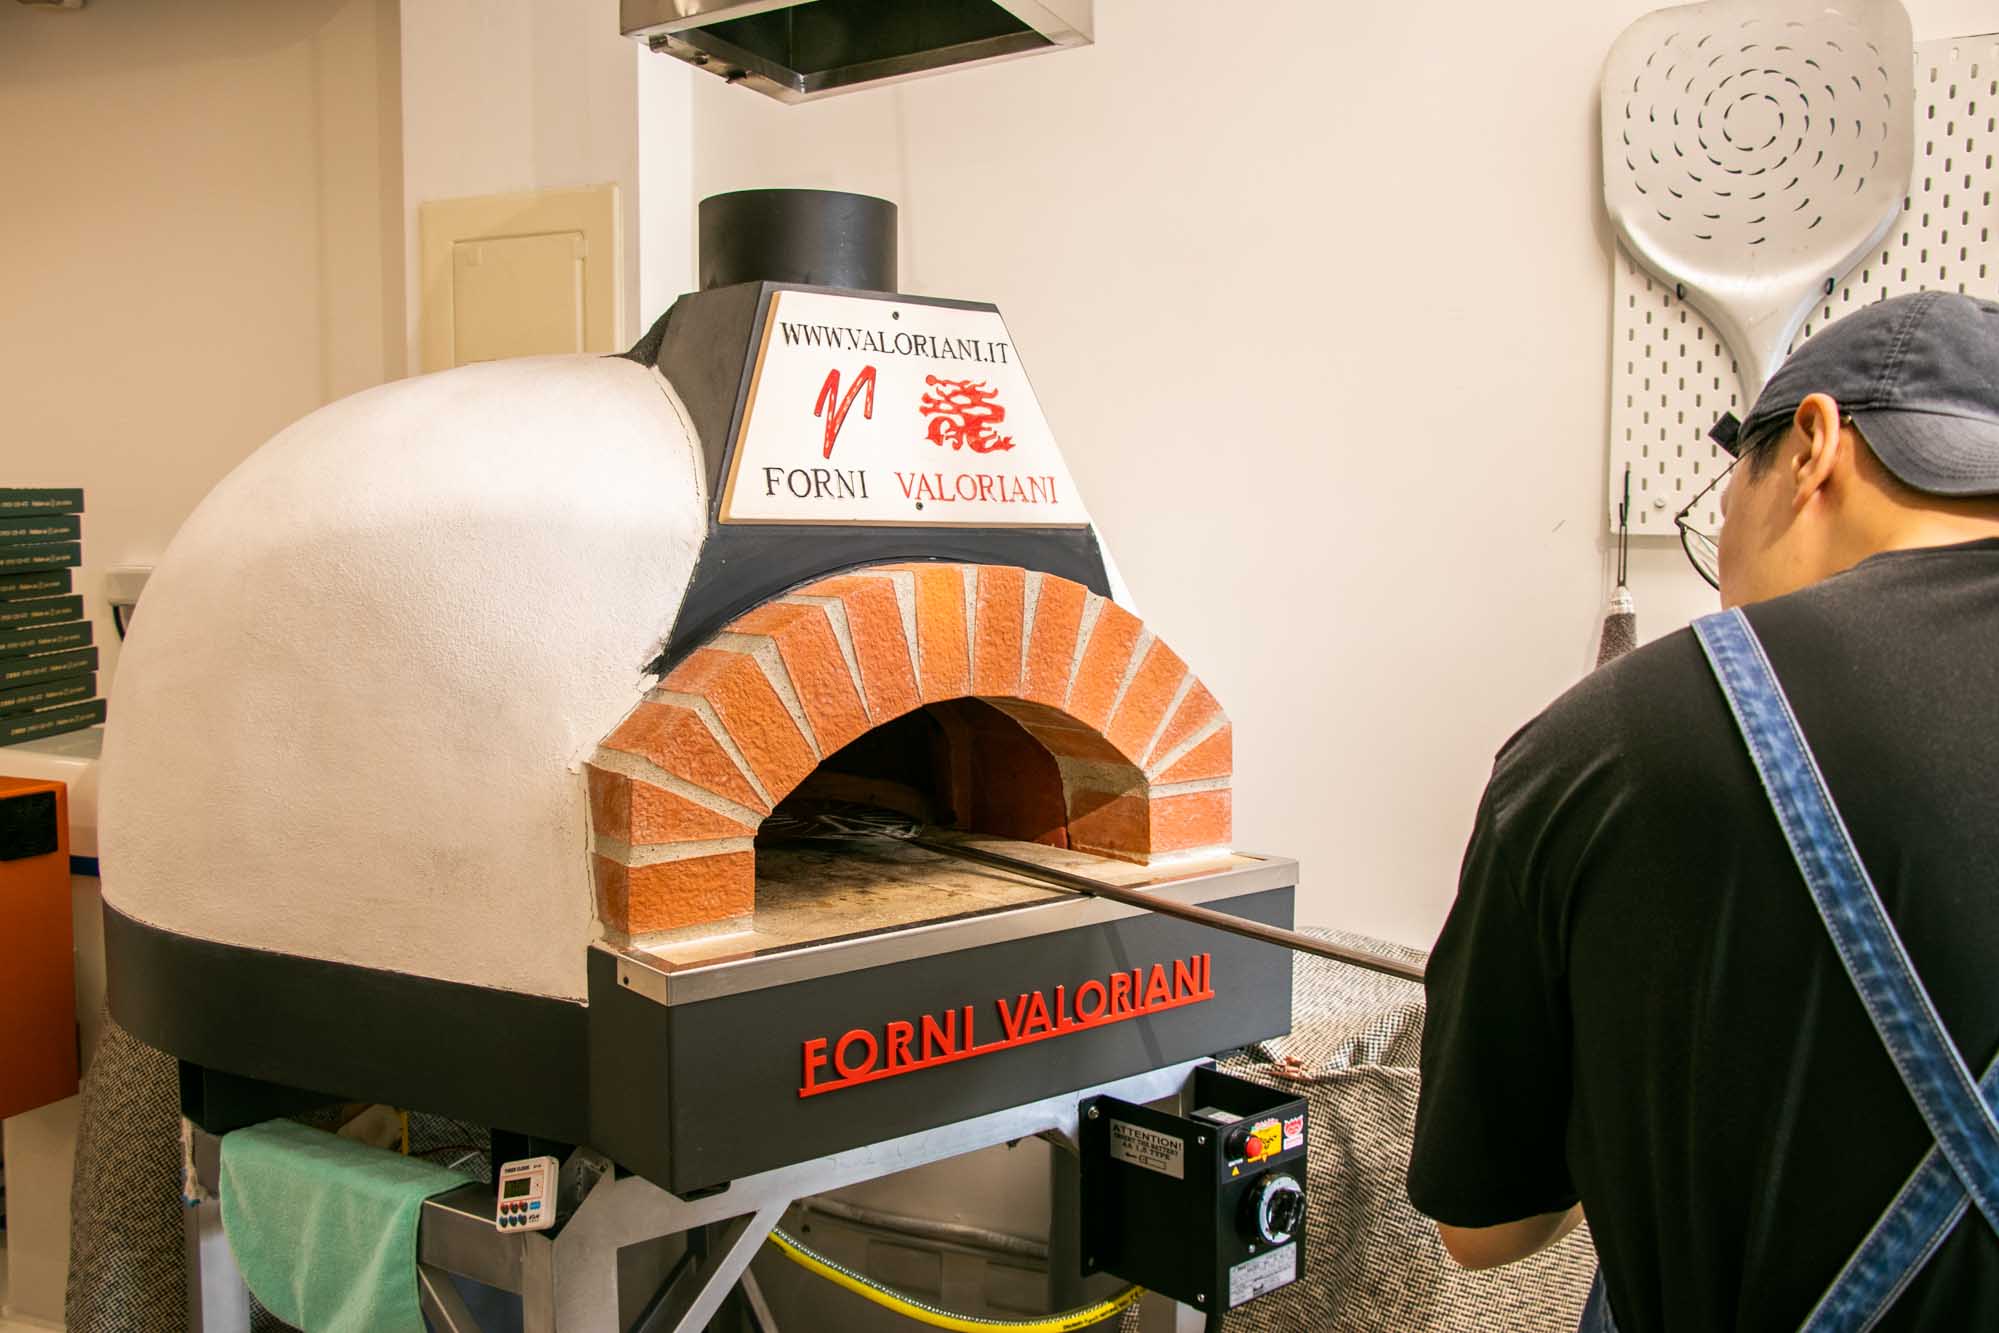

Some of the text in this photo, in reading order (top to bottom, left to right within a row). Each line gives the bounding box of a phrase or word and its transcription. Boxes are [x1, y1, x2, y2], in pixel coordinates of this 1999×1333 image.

[779, 322, 1008, 364] WWW.VALORIANI.IT
[762, 467, 1058, 505] FORNI VALORIANI
[801, 953, 1215, 1093] FORNI VALORIANI
